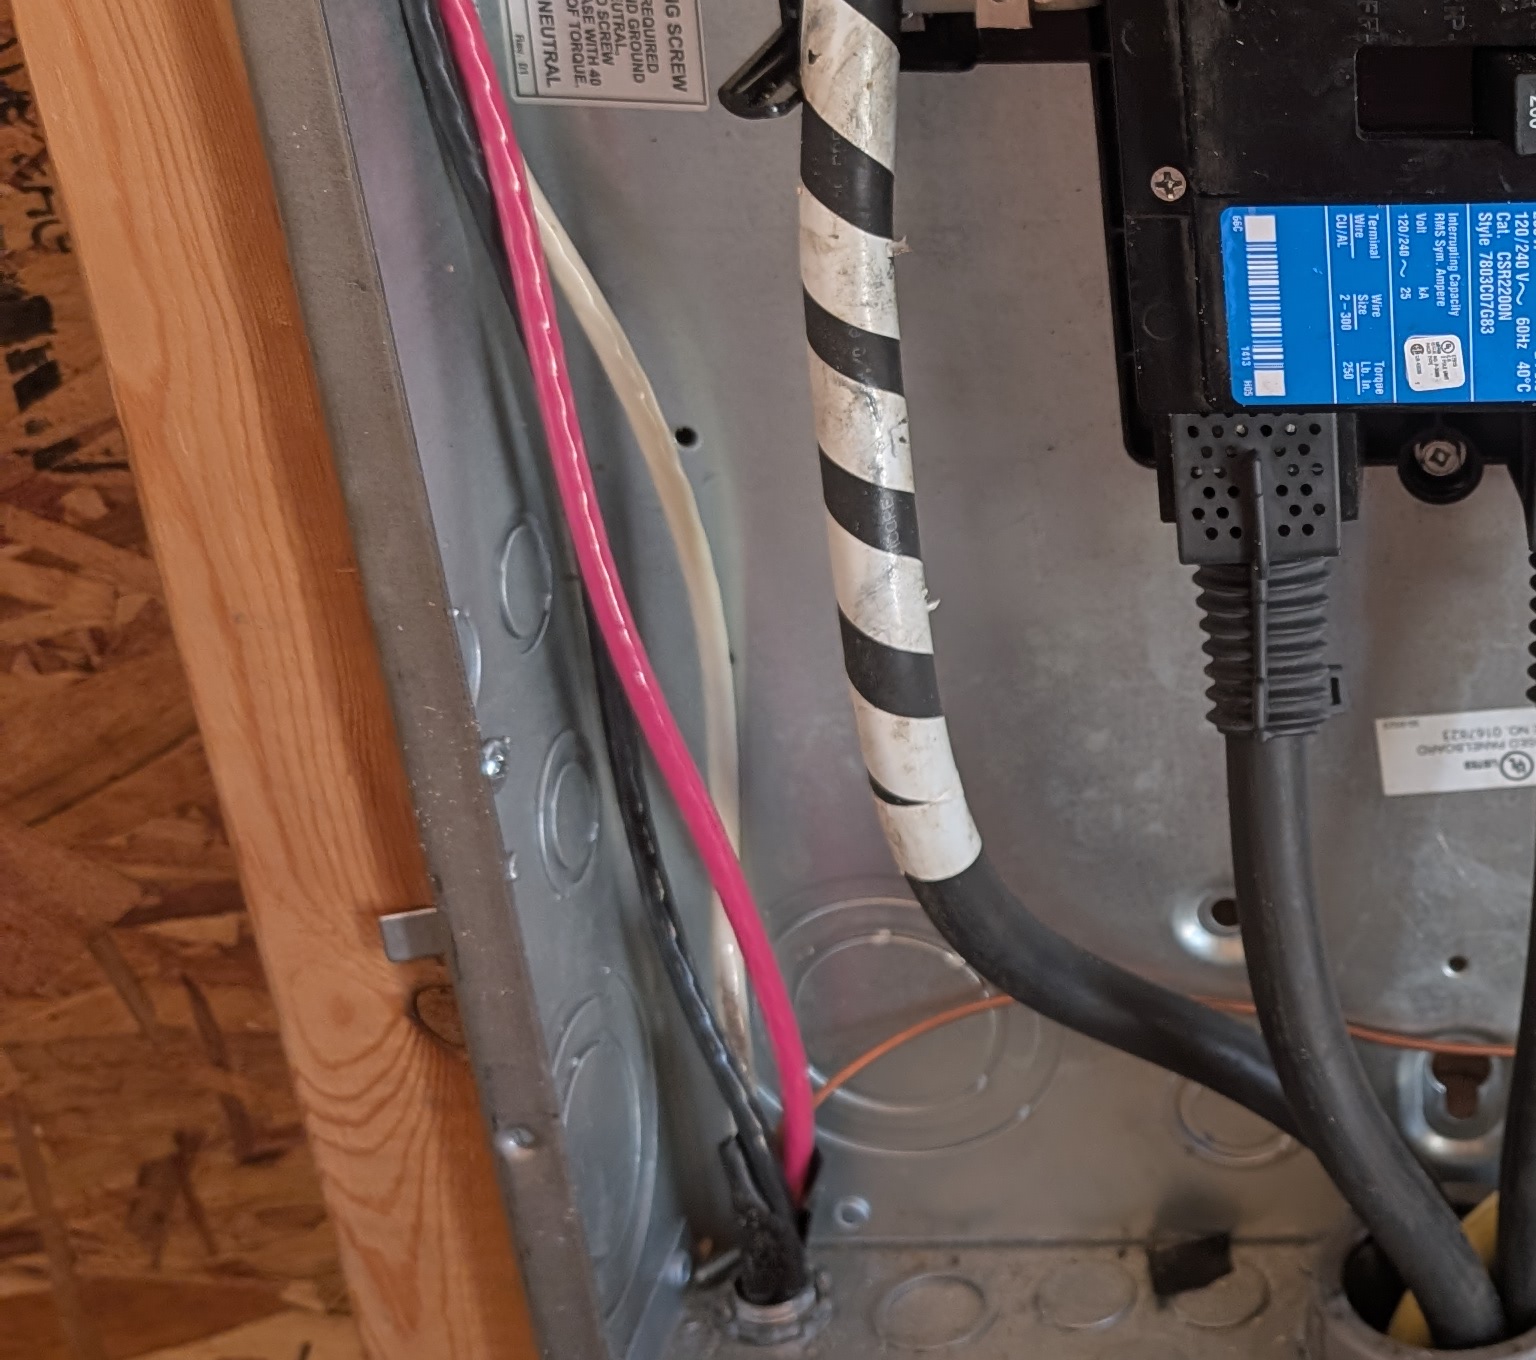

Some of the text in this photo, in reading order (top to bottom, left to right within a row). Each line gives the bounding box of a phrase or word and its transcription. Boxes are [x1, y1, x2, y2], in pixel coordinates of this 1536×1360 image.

[537, 0, 561, 88] NEUTRAL
[568, 21, 586, 89] TORQUE.
[583, 29, 599, 65] WITH
[599, 11, 614, 65] SCREW
[629, 18, 645, 84] GROUND
[666, 23, 688, 93] SCREW
[589, 69, 602, 86] 40
[1335, 214, 1349, 248] CU/AL
[1354, 214, 1364, 238] Wire
[1368, 214, 1380, 259] Terminal
[1398, 213, 1411, 300] 120/240 25
[1416, 213, 1429, 300] Volt kA
[1434, 213, 1447, 307] RMS Sym. Ampere
[1446, 212, 1461, 317] Interrupting Capacity
[1475, 212, 1495, 334] Style 7803C07G83
[1497, 212, 1512, 321] Cat. CSR2200N
[1357, 294, 1369, 315] Size
[1371, 294, 1382, 318] Wire
[1514, 211, 1531, 393] 120/240 60Hz 40°C
[1241, 346, 1251, 367] 1413
[1343, 361, 1354, 380] 250
[1360, 361, 1372, 393] Lb. In.
[1372, 361, 1385, 395] Torque
[1416, 741, 1505, 756] PANELBOARD
